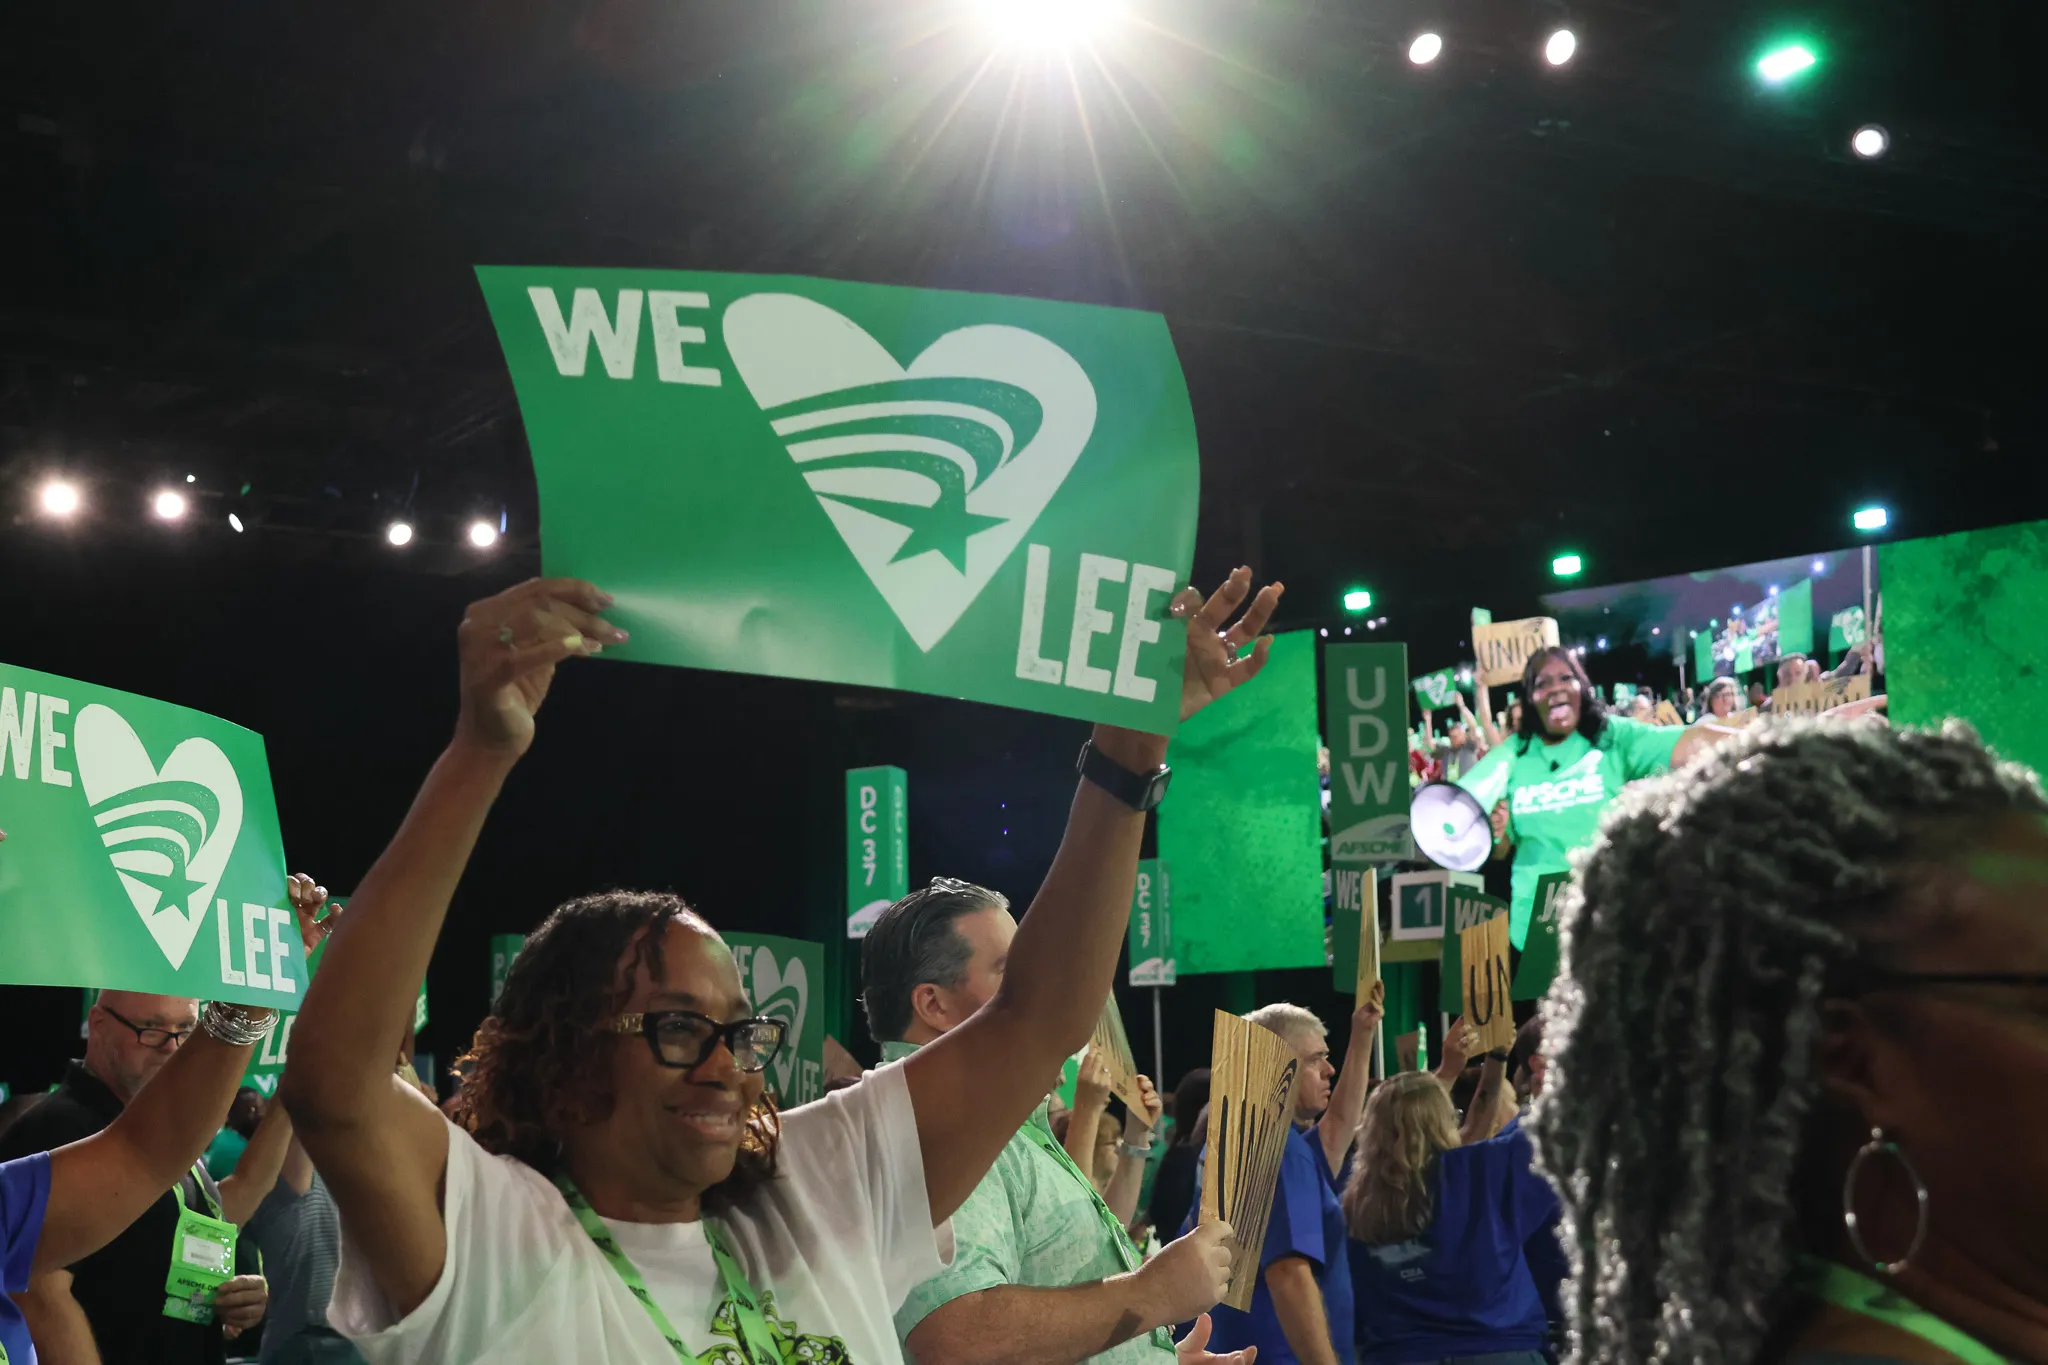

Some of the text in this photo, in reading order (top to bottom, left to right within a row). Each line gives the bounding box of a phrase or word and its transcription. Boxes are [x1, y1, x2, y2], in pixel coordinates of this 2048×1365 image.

[527, 286, 722, 387] WE
[1015, 543, 1176, 702] LEE
[0, 687, 72, 787] WE
[1341, 667, 1398, 805] UDW
[1336, 870, 1361, 911] WE
[1414, 886, 1432, 925] 1
[217, 898, 296, 993] LEE
